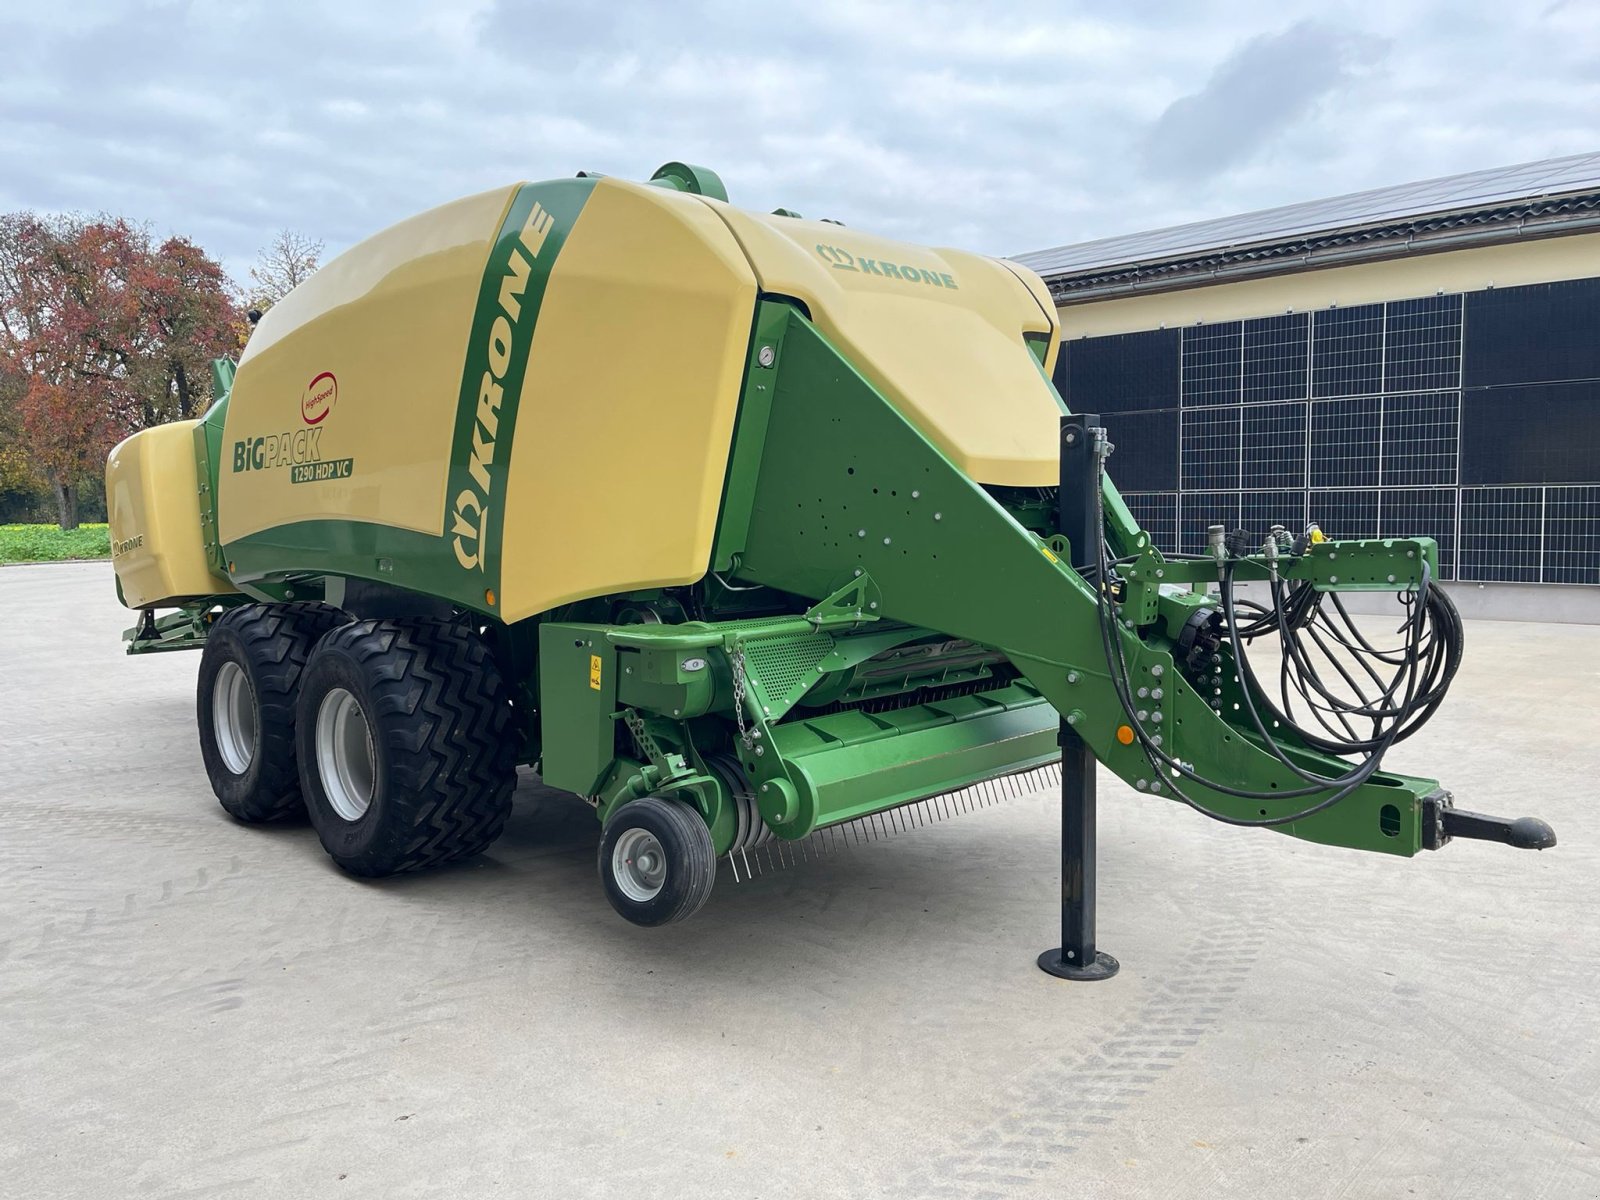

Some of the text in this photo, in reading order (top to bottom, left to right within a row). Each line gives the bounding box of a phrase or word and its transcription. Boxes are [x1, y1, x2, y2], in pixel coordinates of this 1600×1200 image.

[858, 257, 960, 290] KRONE
[469, 201, 555, 496] KRONE
[294, 460, 349, 482] 1290 HDP VC
[119, 535, 143, 555] KRONE
